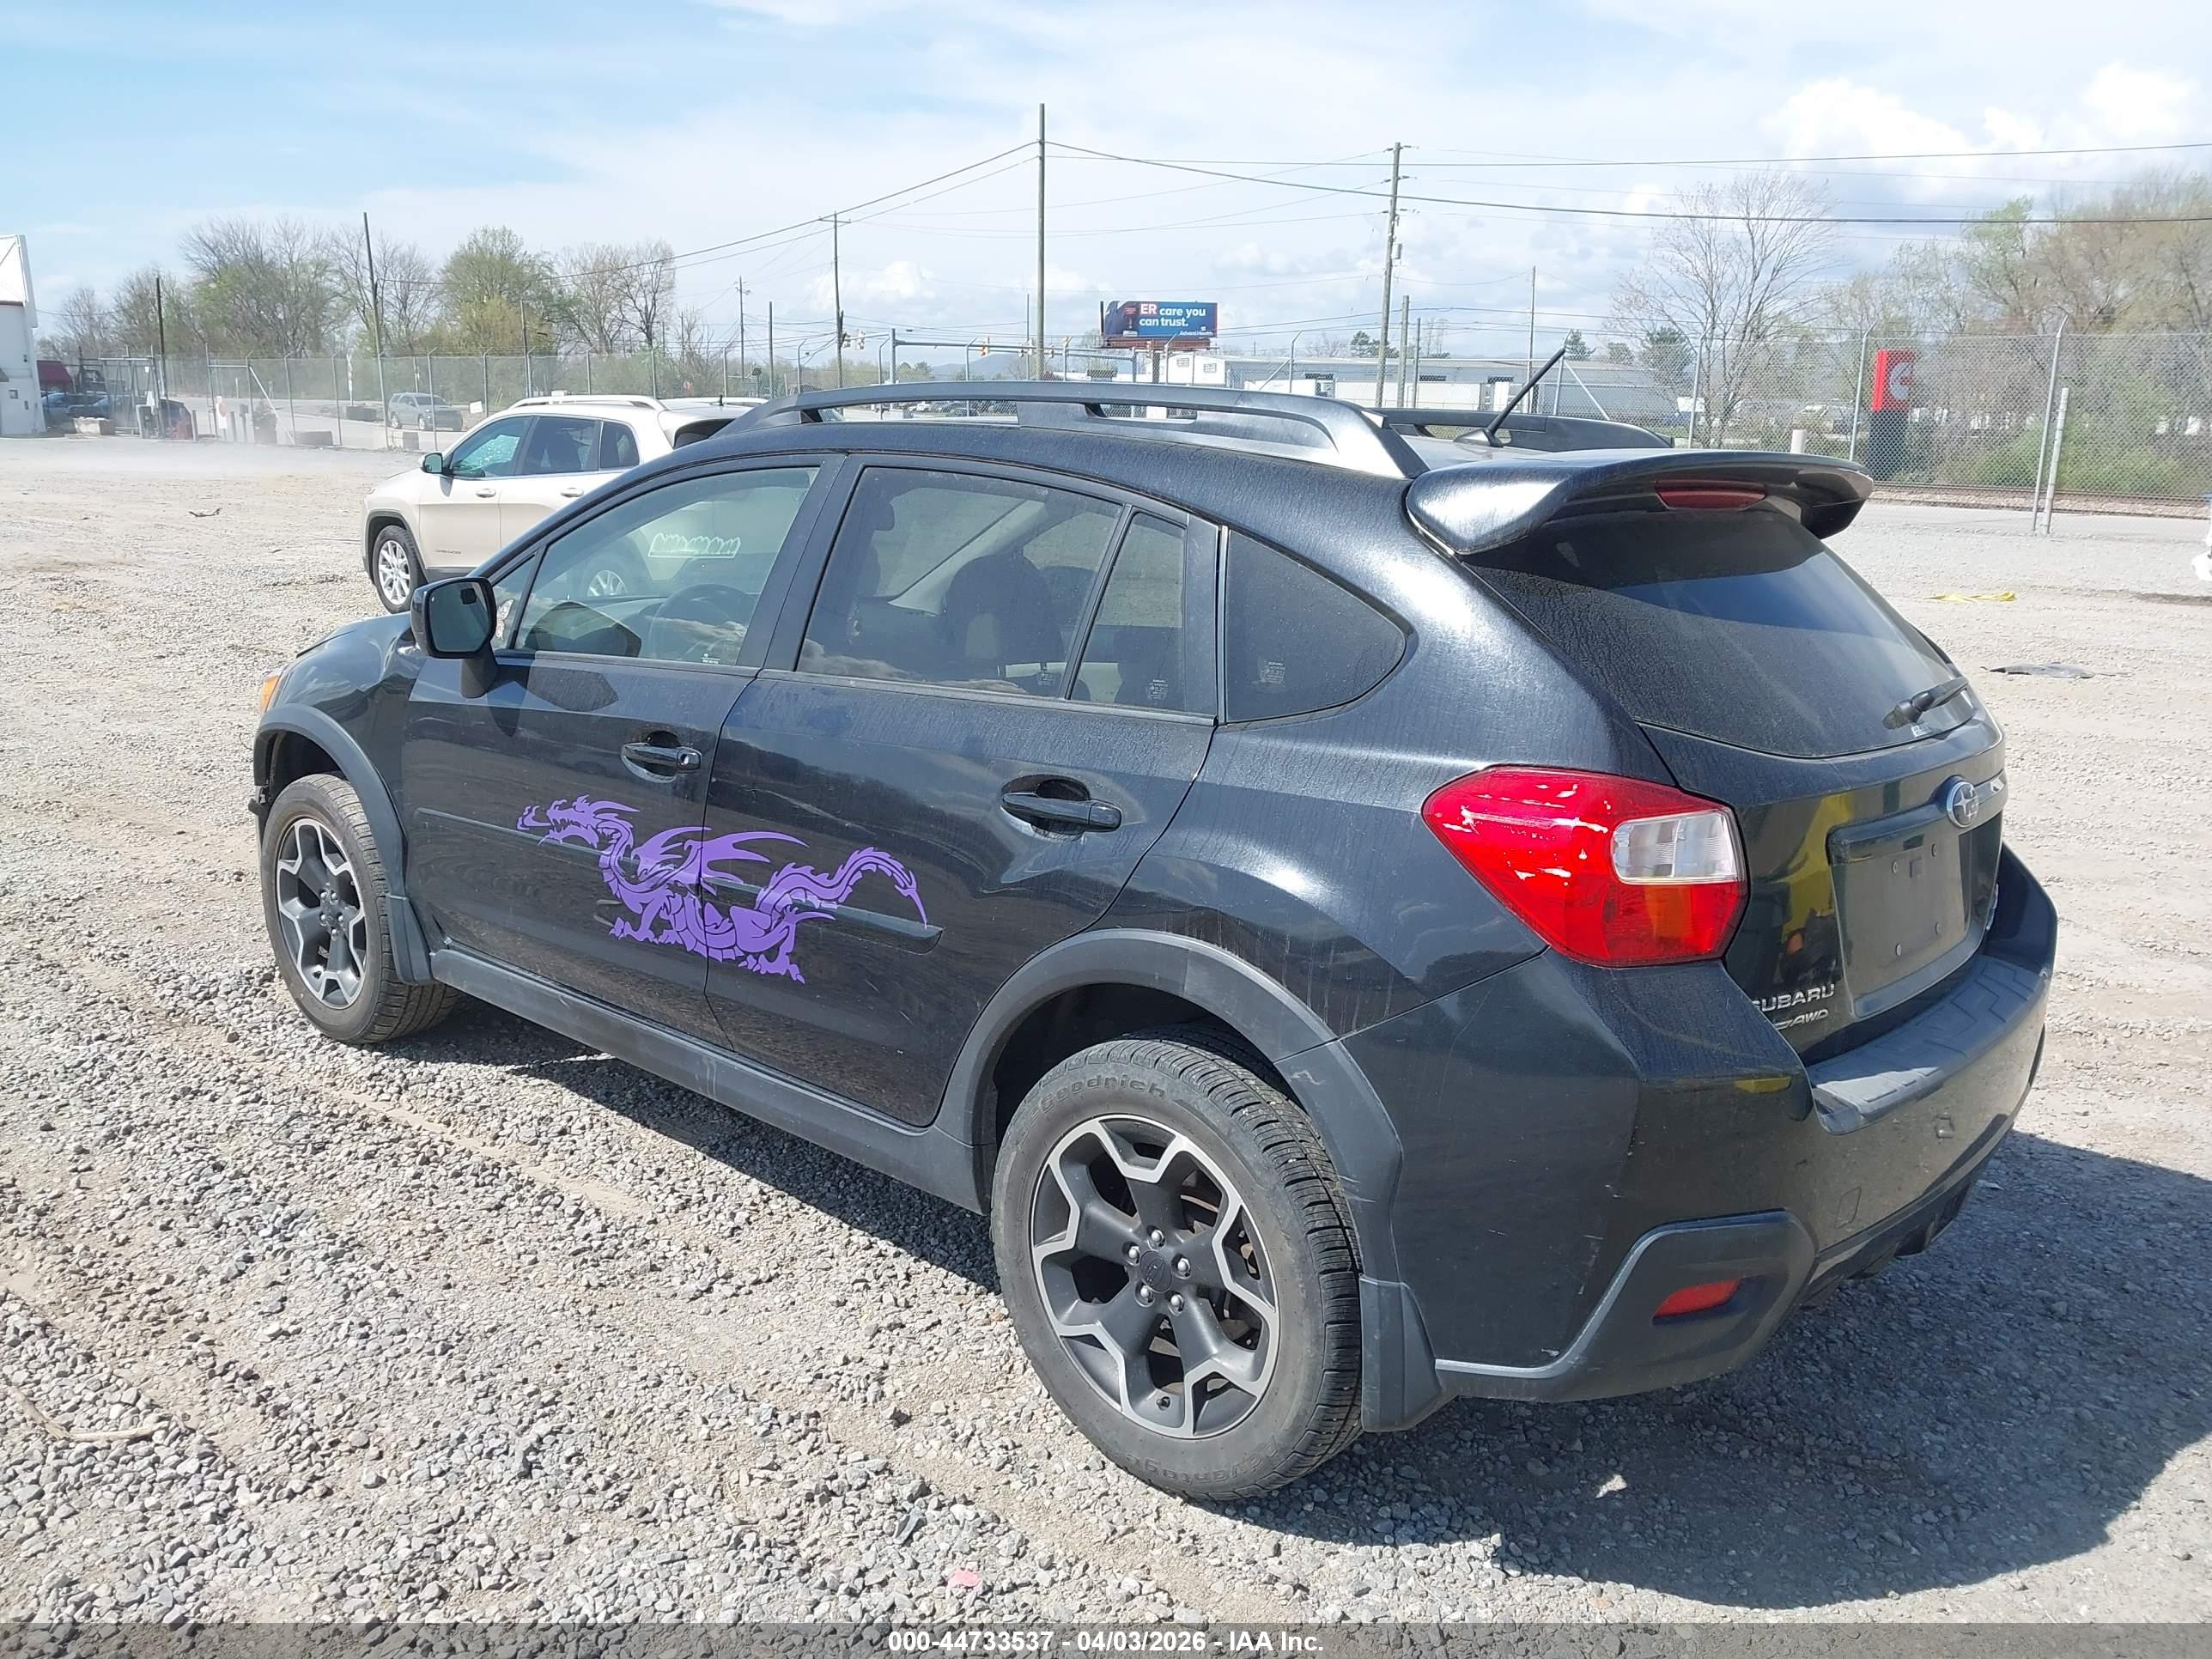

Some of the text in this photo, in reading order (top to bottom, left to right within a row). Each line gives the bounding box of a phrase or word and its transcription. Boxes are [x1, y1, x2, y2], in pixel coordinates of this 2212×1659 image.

[1140, 304, 1206, 319] ER care you
[1139, 317, 1188, 327] can trust.
